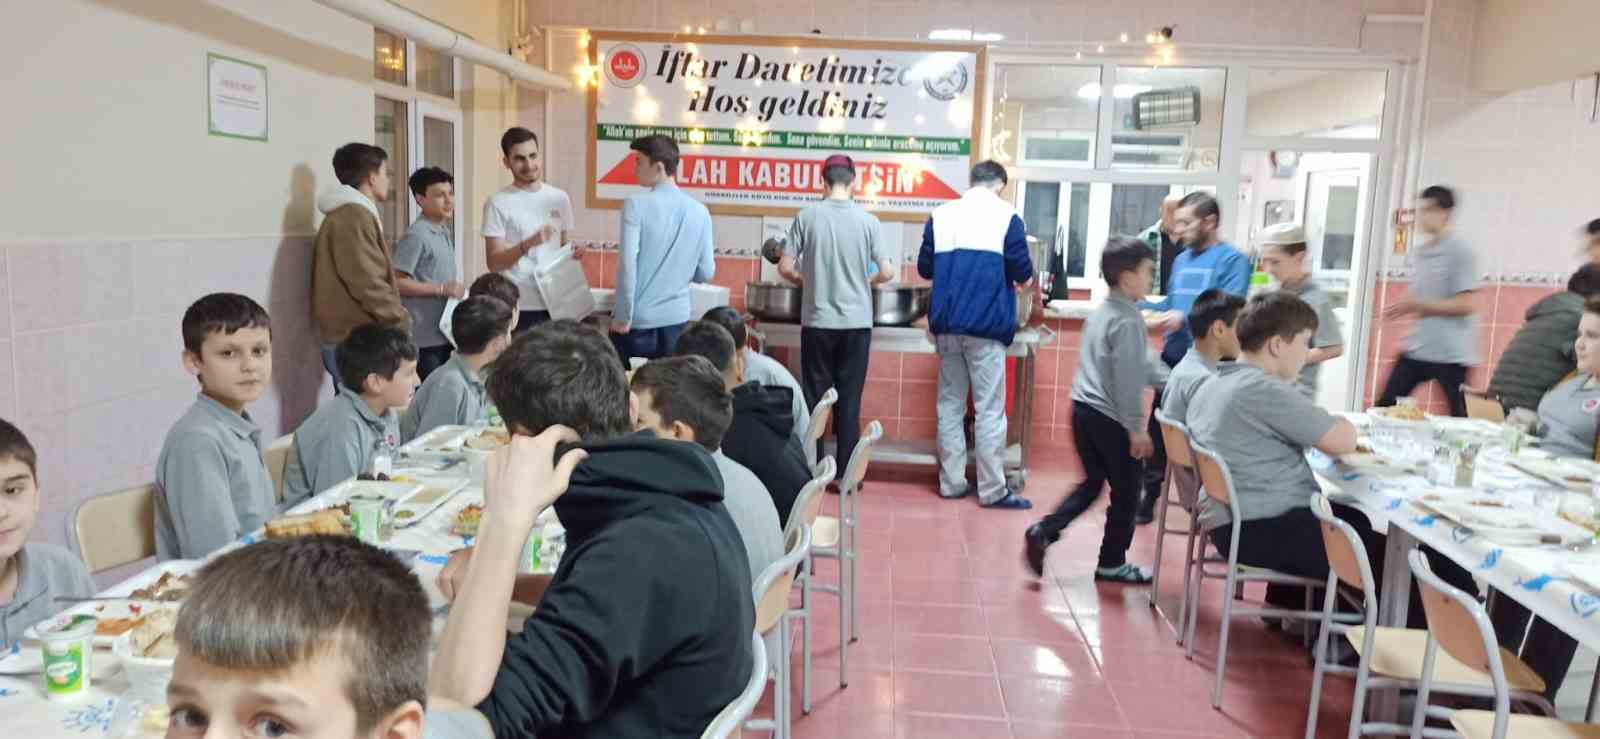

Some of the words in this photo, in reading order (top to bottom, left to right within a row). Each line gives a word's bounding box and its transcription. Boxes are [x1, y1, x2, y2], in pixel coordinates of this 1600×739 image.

[757, 90, 888, 122] geldiniz
[676, 157, 728, 186] LAH
[738, 160, 824, 190] KABUL
